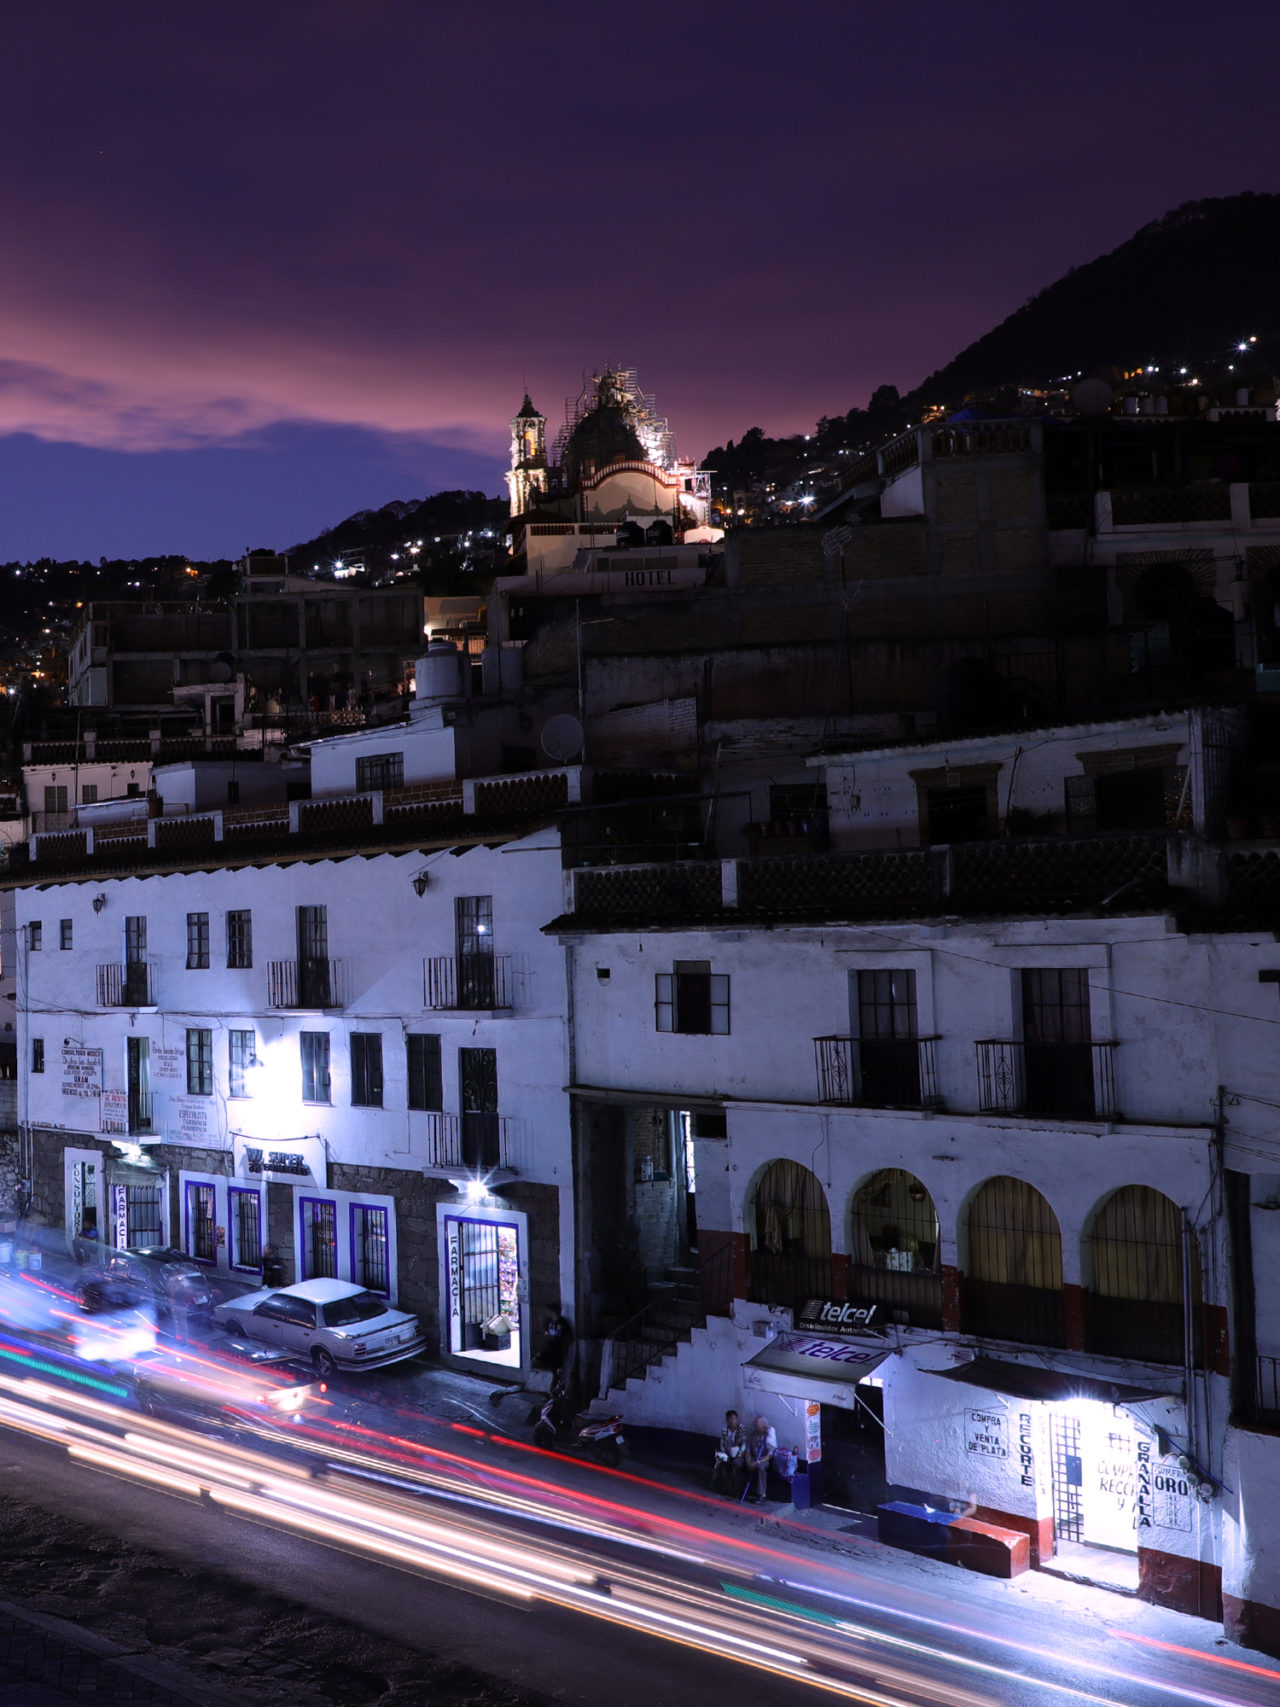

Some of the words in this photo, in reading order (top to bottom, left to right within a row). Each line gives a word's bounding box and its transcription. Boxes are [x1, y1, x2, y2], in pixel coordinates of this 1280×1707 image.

[625, 570, 677, 586] HOTEL
[268, 1151, 304, 1167] SUPER
[73, 1163, 81, 1238] CONSULTORI
[118, 1186, 126, 1251] FARMACIA
[450, 1236, 460, 1317] FARMACIA
[821, 1302, 877, 1324] telcel
[800, 1322, 838, 1332] Distribuidor
[799, 1342, 886, 1364] telcel
[971, 1413, 1001, 1426] COMPRA
[984, 1424, 990, 1433] Y
[968, 1441, 979, 1452] DE
[981, 1444, 1007, 1457] PLATA
[975, 1433, 1000, 1446] VENTA
[1019, 1413, 1033, 1487] RECORTE
[1137, 1441, 1151, 1528] GRANALLA
[1154, 1475, 1188, 1496] ORO
